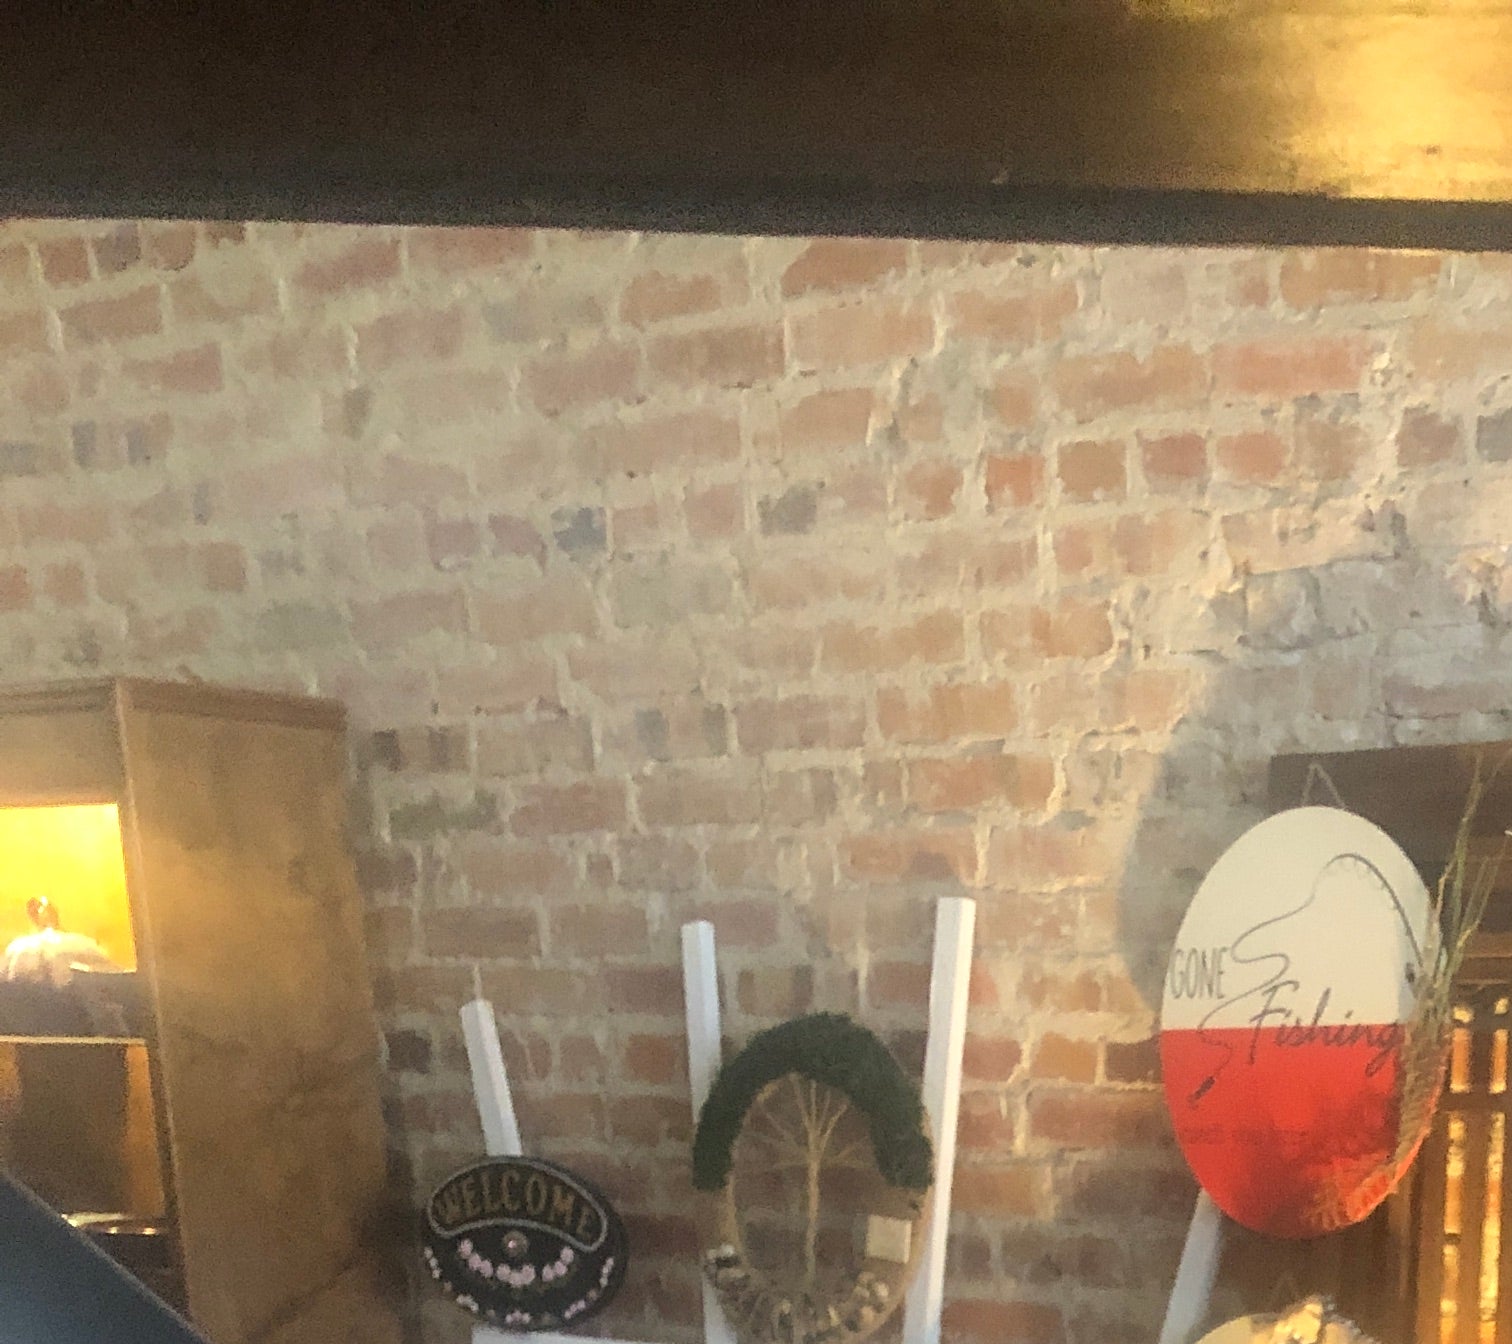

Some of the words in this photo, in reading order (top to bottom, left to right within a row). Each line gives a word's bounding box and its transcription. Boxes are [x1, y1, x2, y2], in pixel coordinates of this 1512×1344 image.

[1170, 947, 1228, 999] GONE
[1248, 980, 1400, 1078] Fishing
[431, 1168, 598, 1239] WELCOME
